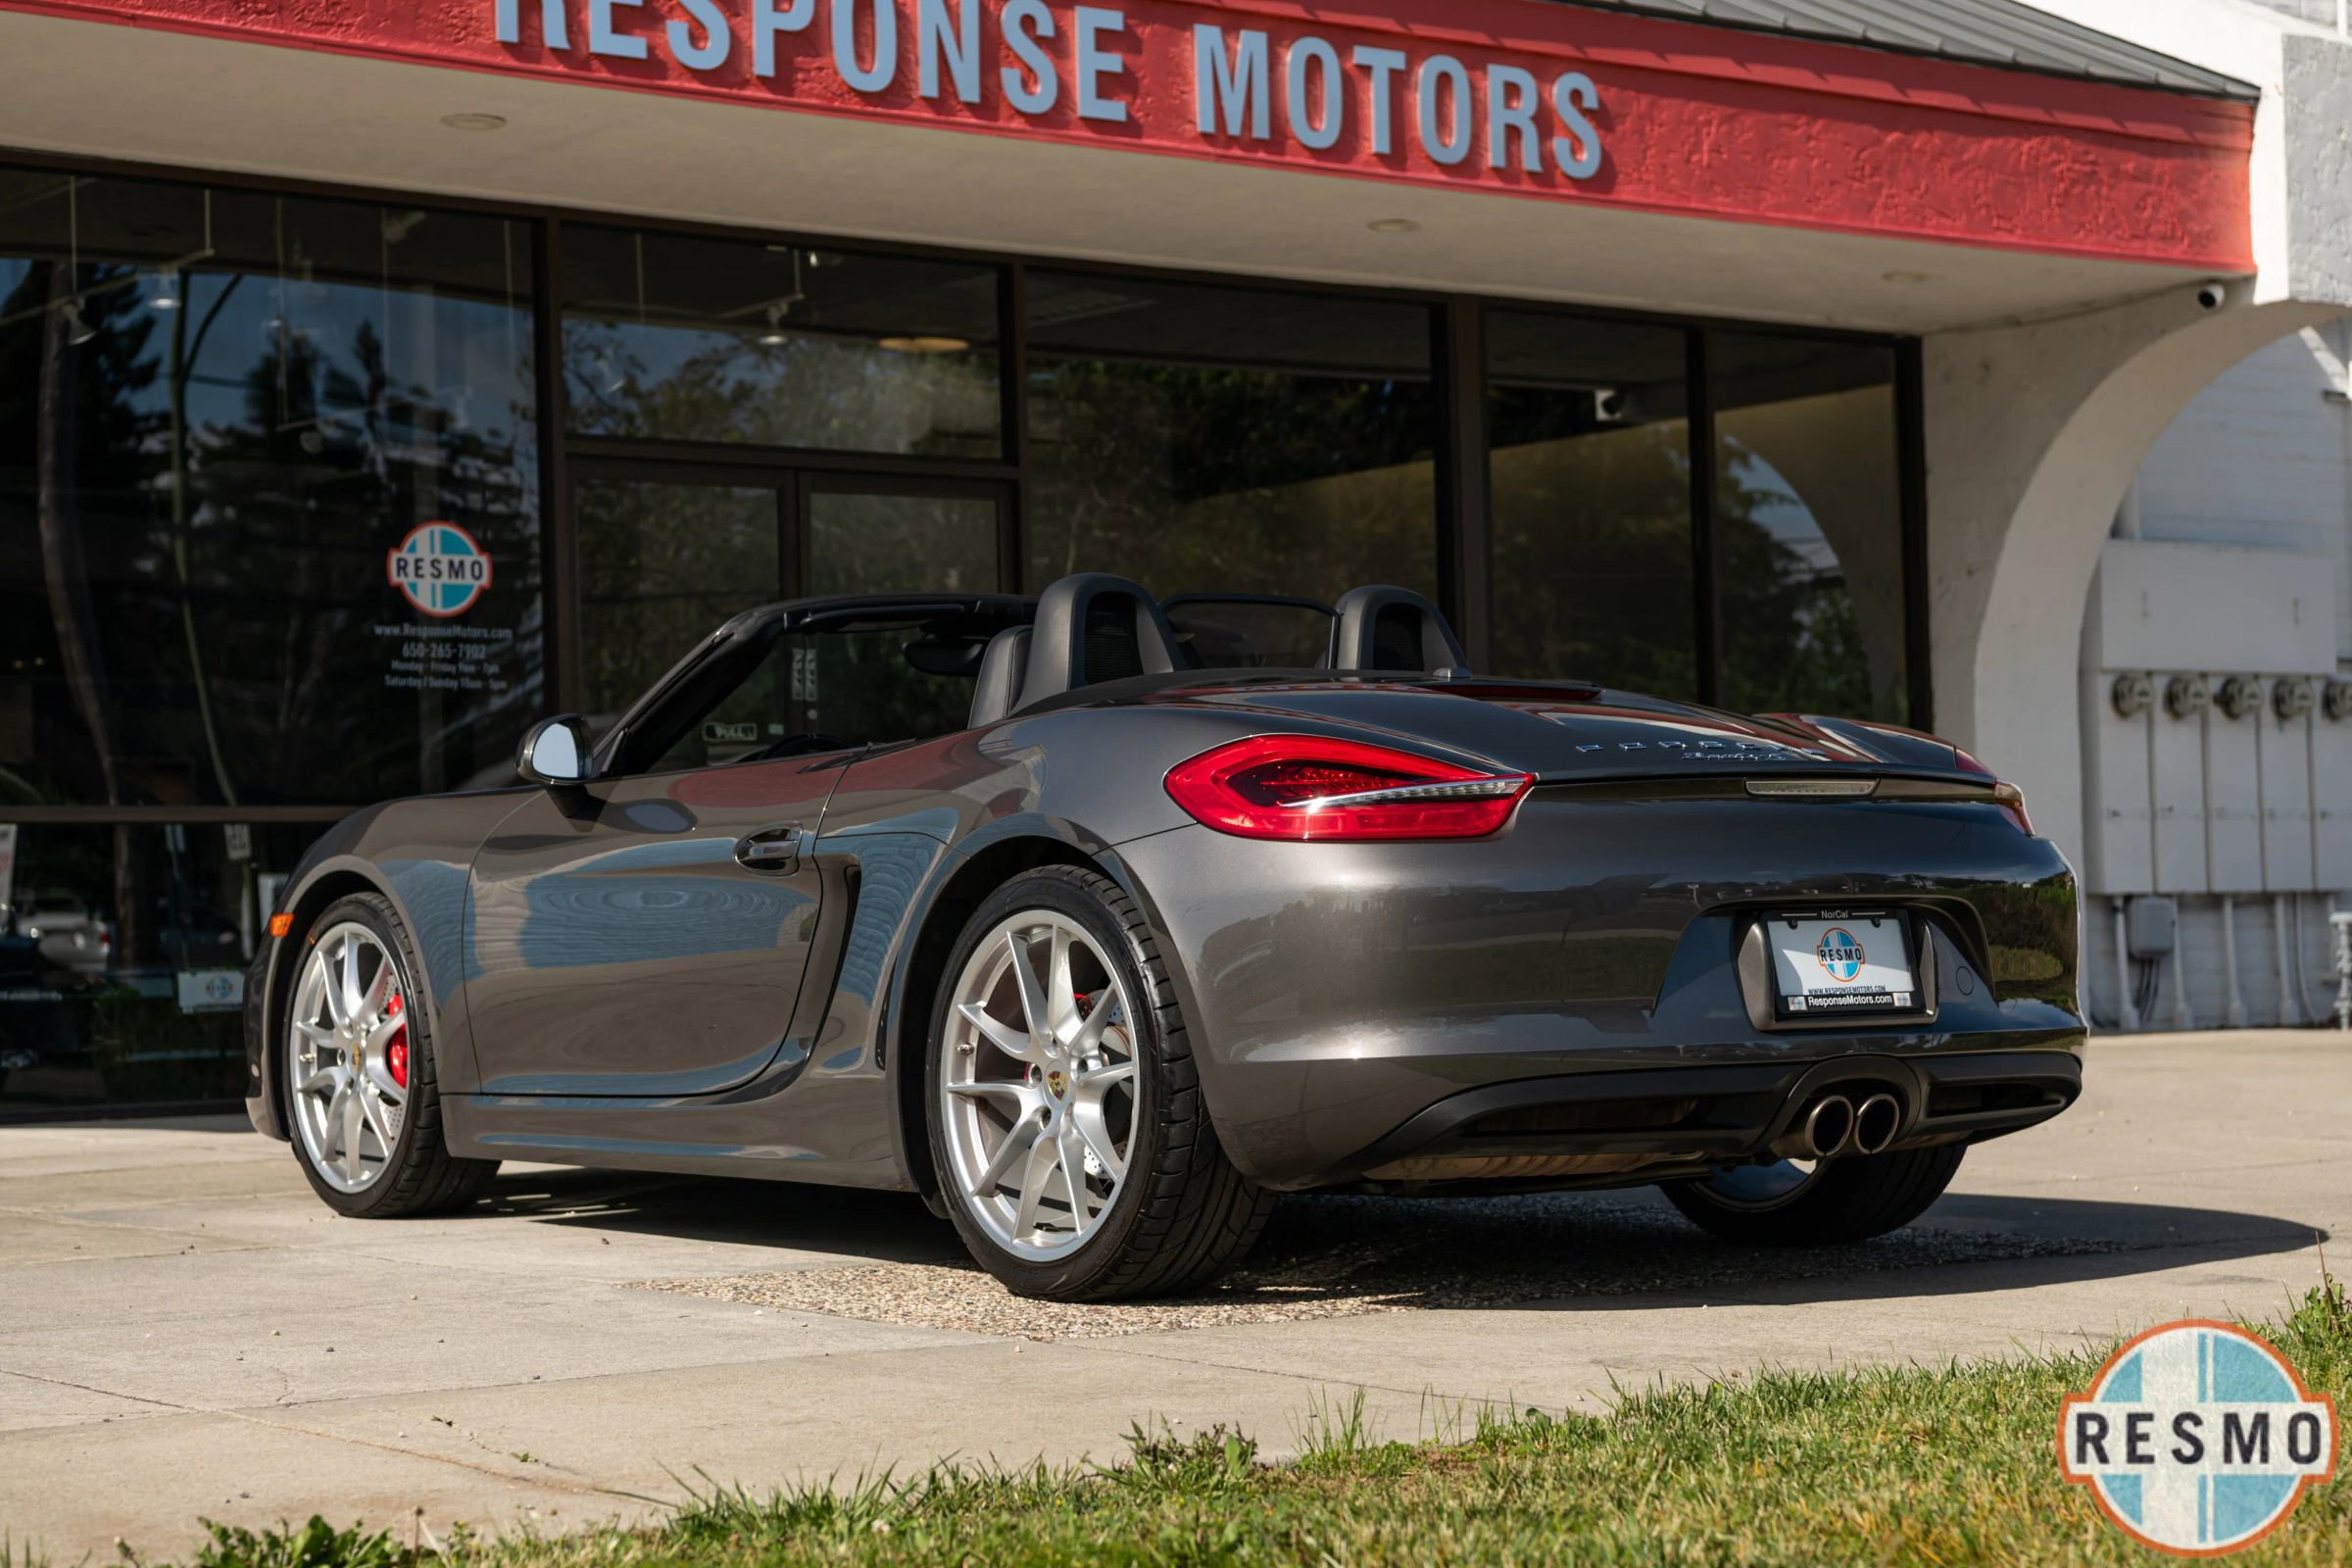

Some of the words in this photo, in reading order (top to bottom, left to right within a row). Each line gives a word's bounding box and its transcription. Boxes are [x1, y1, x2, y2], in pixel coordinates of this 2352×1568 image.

[1193, 24, 1602, 179] MOTORS
[396, 558, 483, 580] RESMO
[1820, 948, 1862, 962] RESMO
[1808, 995, 1892, 1007] ResponseMotors.com
